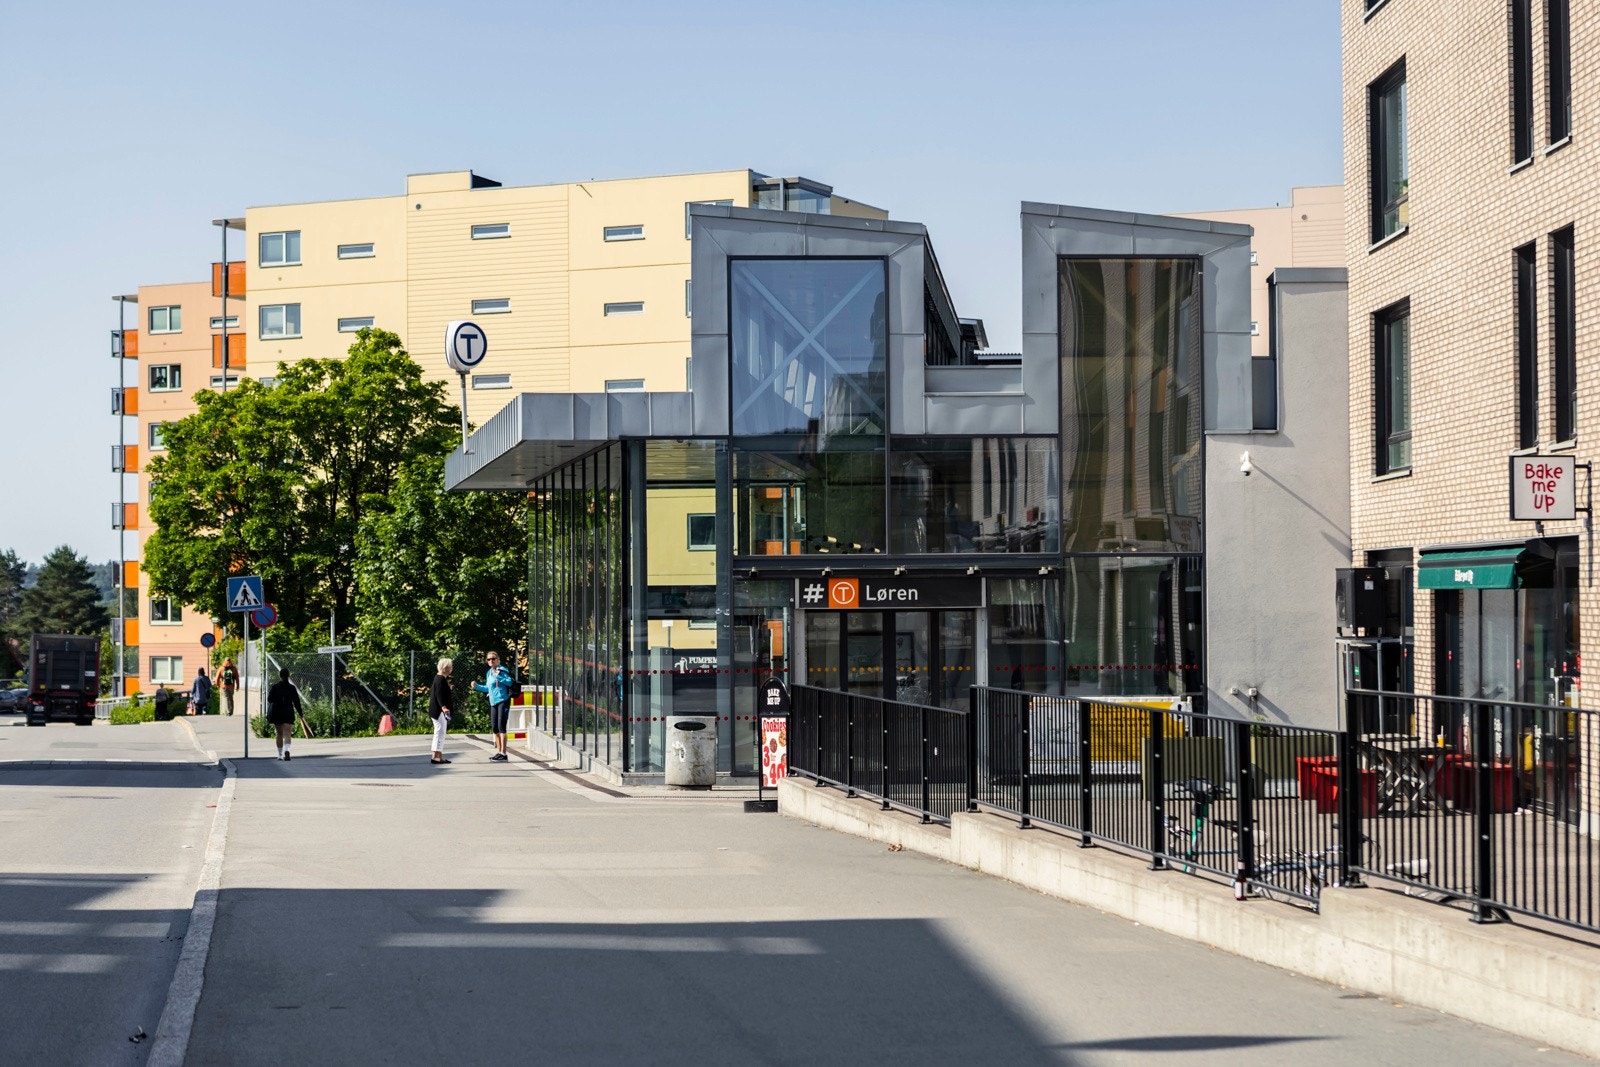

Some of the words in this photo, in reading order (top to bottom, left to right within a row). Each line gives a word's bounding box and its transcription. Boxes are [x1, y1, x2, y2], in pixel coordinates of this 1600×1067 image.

[460, 334, 478, 359] T
[1525, 463, 1563, 480] Bake
[1532, 480, 1557, 494] me
[866, 585, 919, 602] Løren
[763, 719, 787, 733] Cookies
[763, 745, 770, 768] 3
